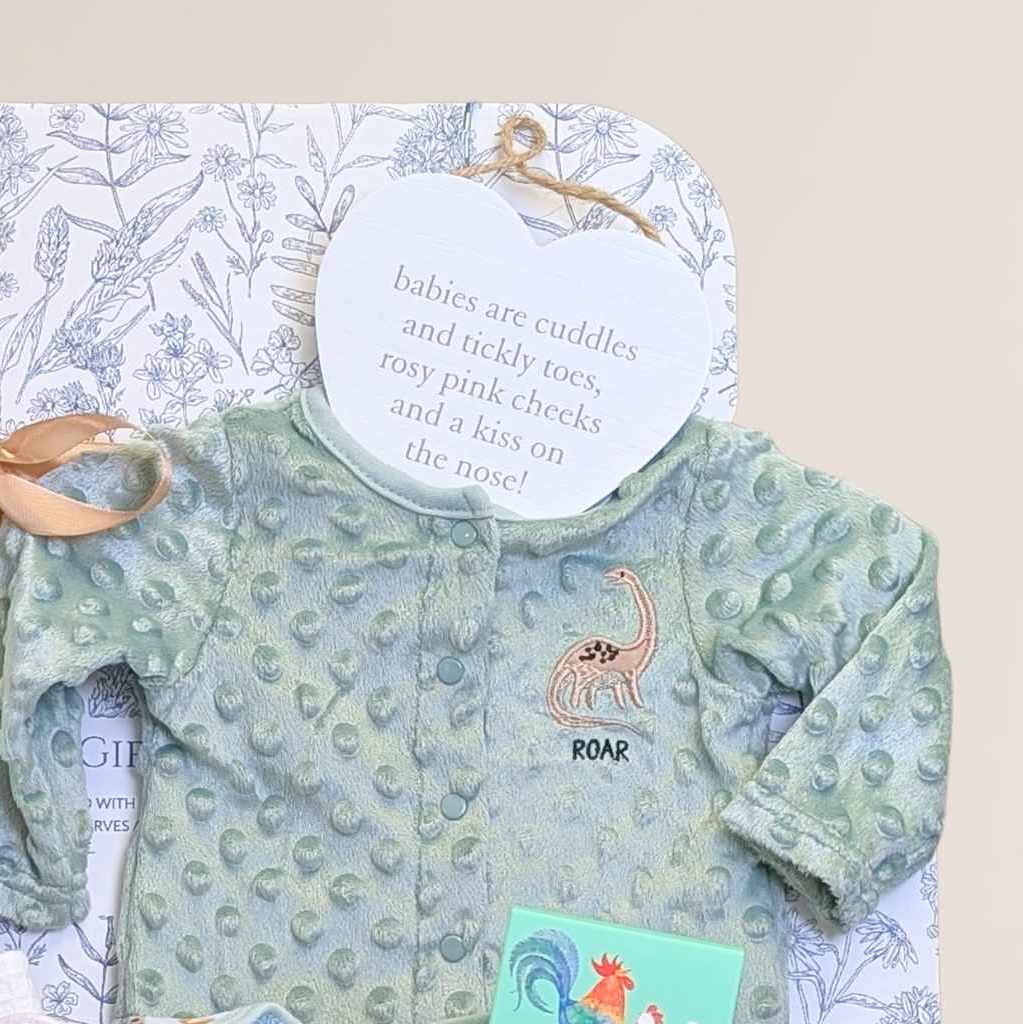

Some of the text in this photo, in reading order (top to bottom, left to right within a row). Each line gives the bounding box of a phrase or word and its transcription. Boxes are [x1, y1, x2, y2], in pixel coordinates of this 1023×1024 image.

[392, 265, 639, 363] babies are cuddles
[402, 314, 602, 399] and tickly toes,
[379, 352, 603, 434] rosy pink cheeks
[390, 398, 565, 465] and a kiss on
[404, 439, 528, 494] the nose!
[572, 738, 629, 762] ROAR
[96, 798, 136, 810] WITH
